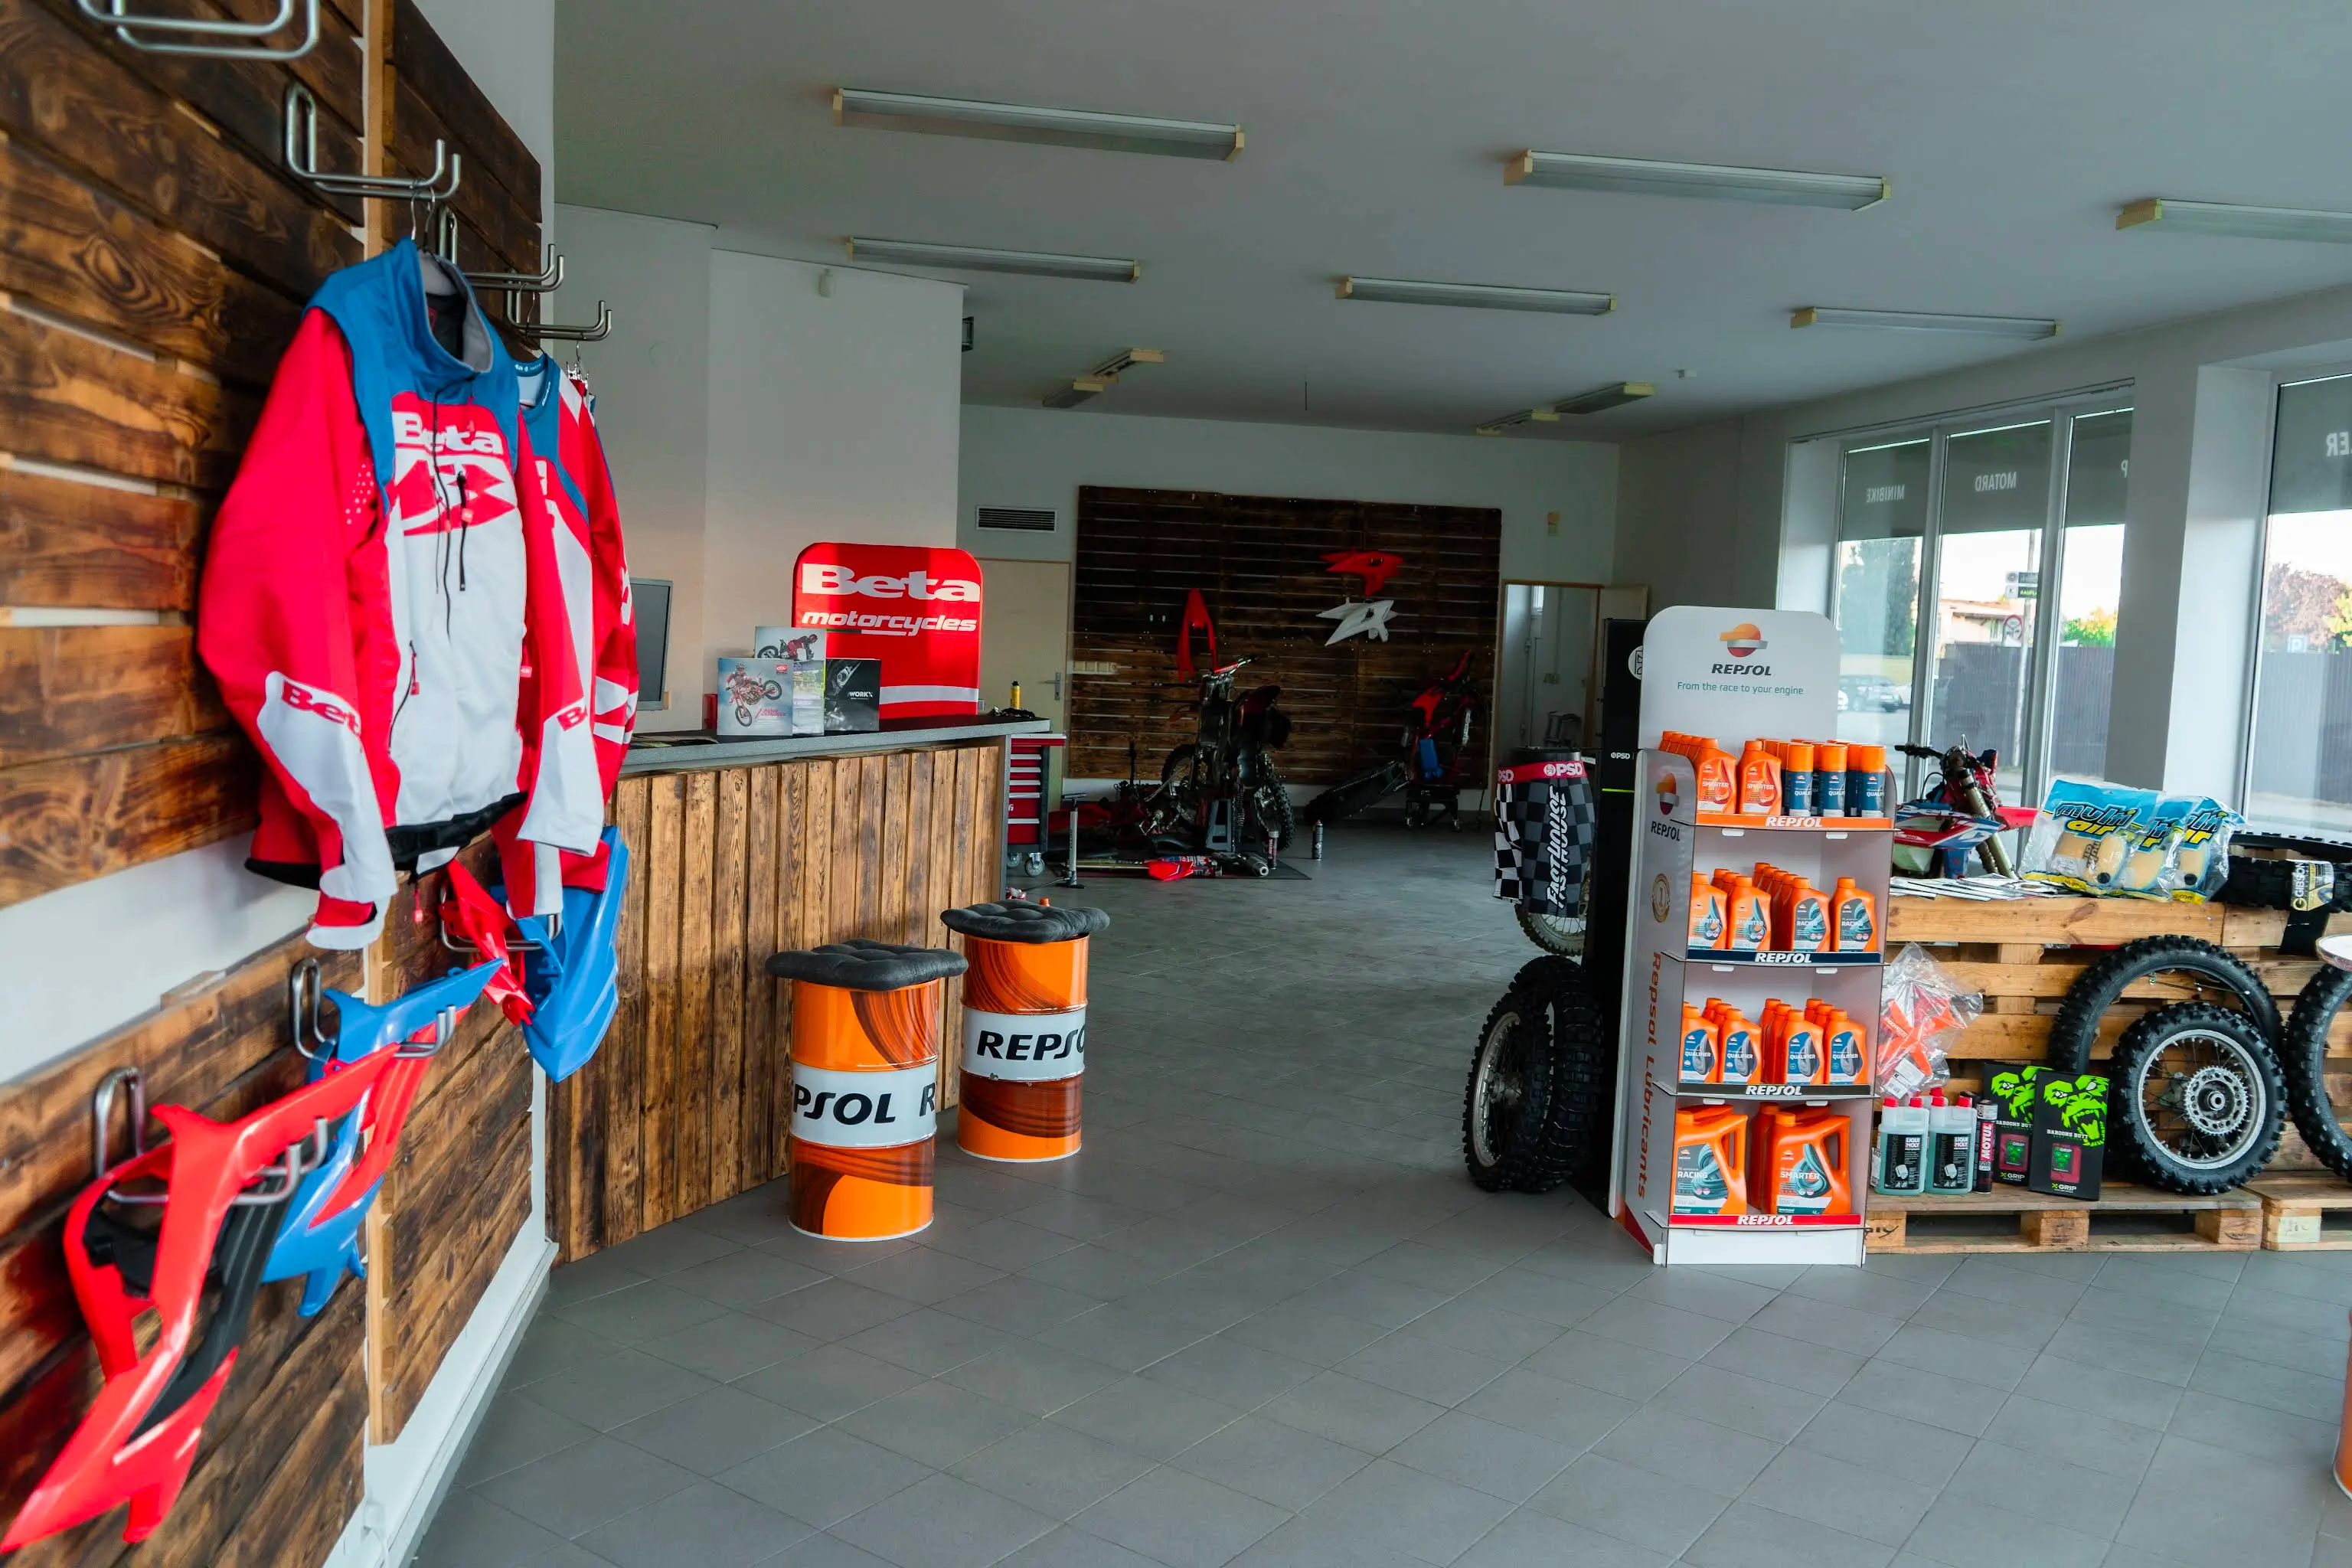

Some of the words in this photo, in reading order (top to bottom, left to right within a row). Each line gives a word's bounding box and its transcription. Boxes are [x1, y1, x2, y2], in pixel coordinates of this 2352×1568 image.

[392, 411, 503, 455] Beta
[802, 564, 981, 603] Beta
[802, 610, 977, 637] motorcycles
[1711, 663, 1772, 676] REPSOL
[1677, 681, 1699, 691] From
[1702, 682, 1717, 691] the
[1753, 686, 1772, 694] your
[1774, 687, 1804, 696] engine
[1557, 763, 1583, 777] PSD
[1766, 816, 1822, 828] REPSOL
[2055, 804, 2136, 827] multi
[1651, 820, 1681, 841] REPSOL
[2067, 820, 2115, 835] air
[1547, 785, 1570, 910] FASTHOUSE
[2295, 862, 2306, 897] GIBSON
[1755, 952, 1811, 963] REPSOL
[1648, 952, 1661, 1046] Repsol
[1746, 1085, 1802, 1096] REPSOL
[1638, 1054, 1656, 1200] Lubricants
[1981, 1124, 1992, 1160] MOTUL
[1780, 1171, 1820, 1180] SMARTER
[1737, 1215, 1793, 1225] REPSOL
